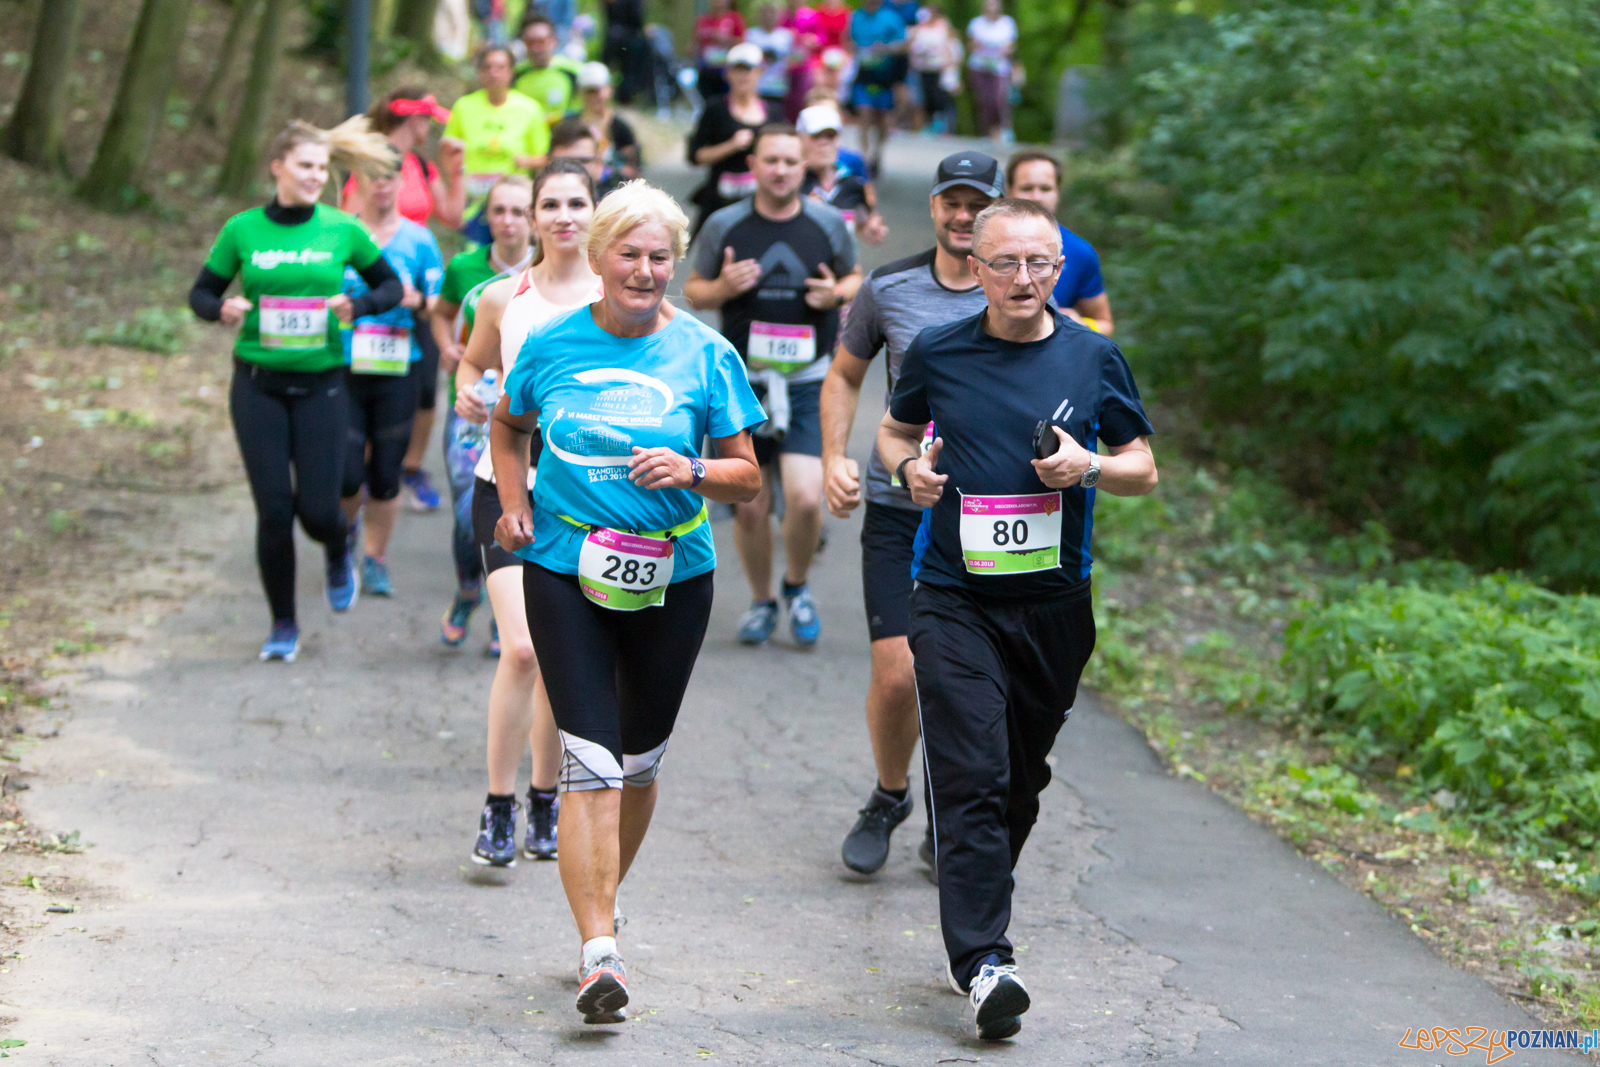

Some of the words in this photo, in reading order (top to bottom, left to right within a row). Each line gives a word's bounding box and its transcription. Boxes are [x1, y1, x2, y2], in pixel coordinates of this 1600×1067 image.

[277, 312, 310, 329] 383
[766, 340, 799, 356] 180
[567, 411, 575, 419] VI
[576, 412, 601, 421] MARSZ
[601, 415, 629, 424] NORDIC
[630, 416, 663, 424] WALKING
[588, 473, 628, 483] 16.10.2016
[992, 519, 1029, 546] 80
[601, 554, 657, 585] 283
